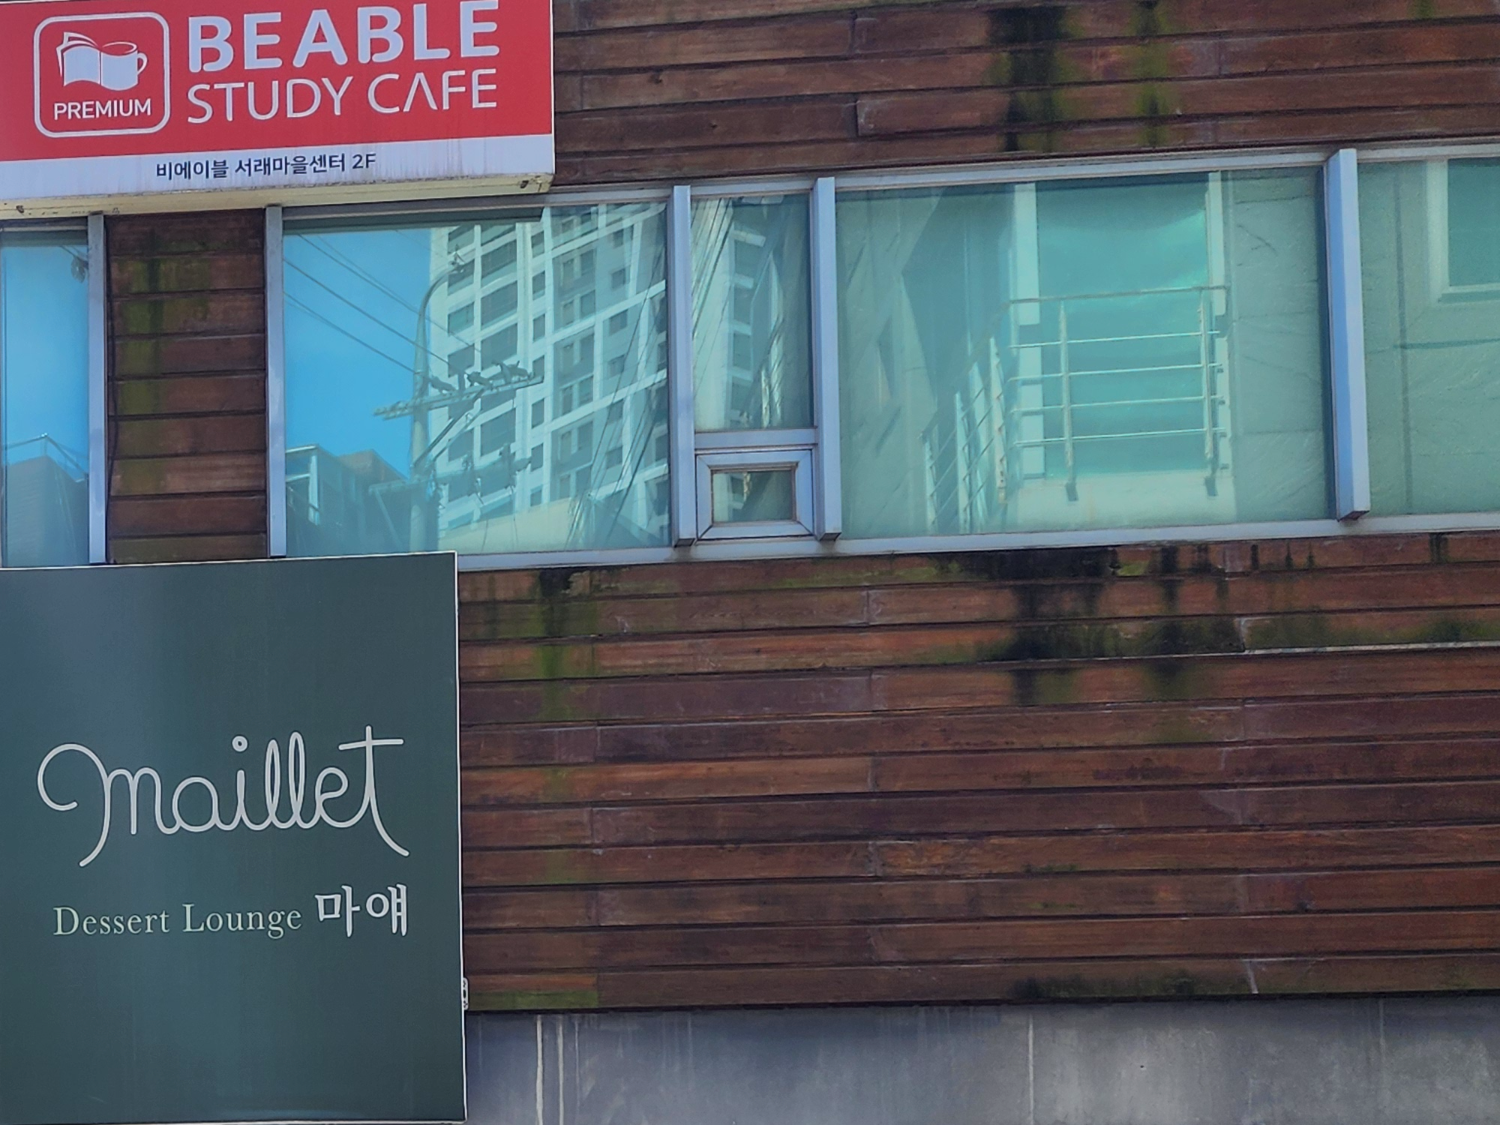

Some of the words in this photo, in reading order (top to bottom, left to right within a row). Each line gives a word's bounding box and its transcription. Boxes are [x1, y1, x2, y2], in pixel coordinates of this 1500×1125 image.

[187, 0, 500, 73] BEABLE
[54, 98, 151, 120] PREMIUM
[187, 76, 353, 123] STUDY
[368, 68, 498, 114] CAFE
[156, 160, 229, 180] 비에이블
[235, 153, 345, 177] 서래마을센터
[352, 153, 376, 170] 2F
[53, 907, 170, 936] Dessert
[182, 904, 302, 939] Lounge
